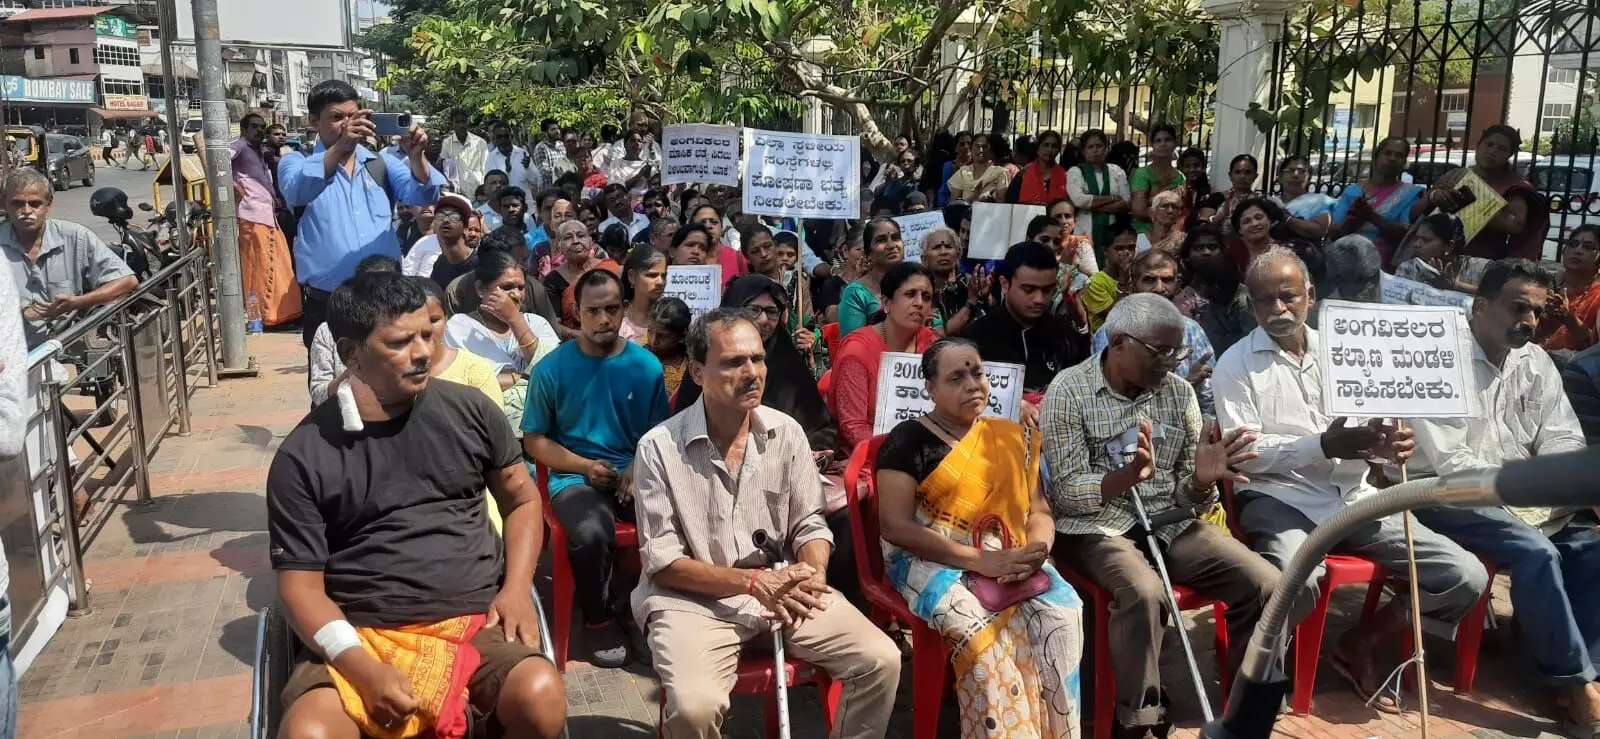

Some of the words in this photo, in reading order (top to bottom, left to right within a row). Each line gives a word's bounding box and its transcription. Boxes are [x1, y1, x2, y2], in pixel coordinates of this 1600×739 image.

[24, 79, 67, 98] BOMBAY
[69, 81, 92, 100] SALE
[670, 137, 730, 147] ಅಂಗವಿಕಲರ
[755, 136, 785, 151] ಎಲ್ಲಾ
[751, 171, 813, 192] ಪೋಷಣಾ
[753, 195, 846, 210] ನೀಡಲೇಬೇಕು.
[1334, 316, 1446, 338] ಅಂಗವಿಕಲರ
[1331, 341, 1383, 377] ಕಲ್ಯಾಣ
[1391, 344, 1455, 369] ಮಂಡಳಿ
